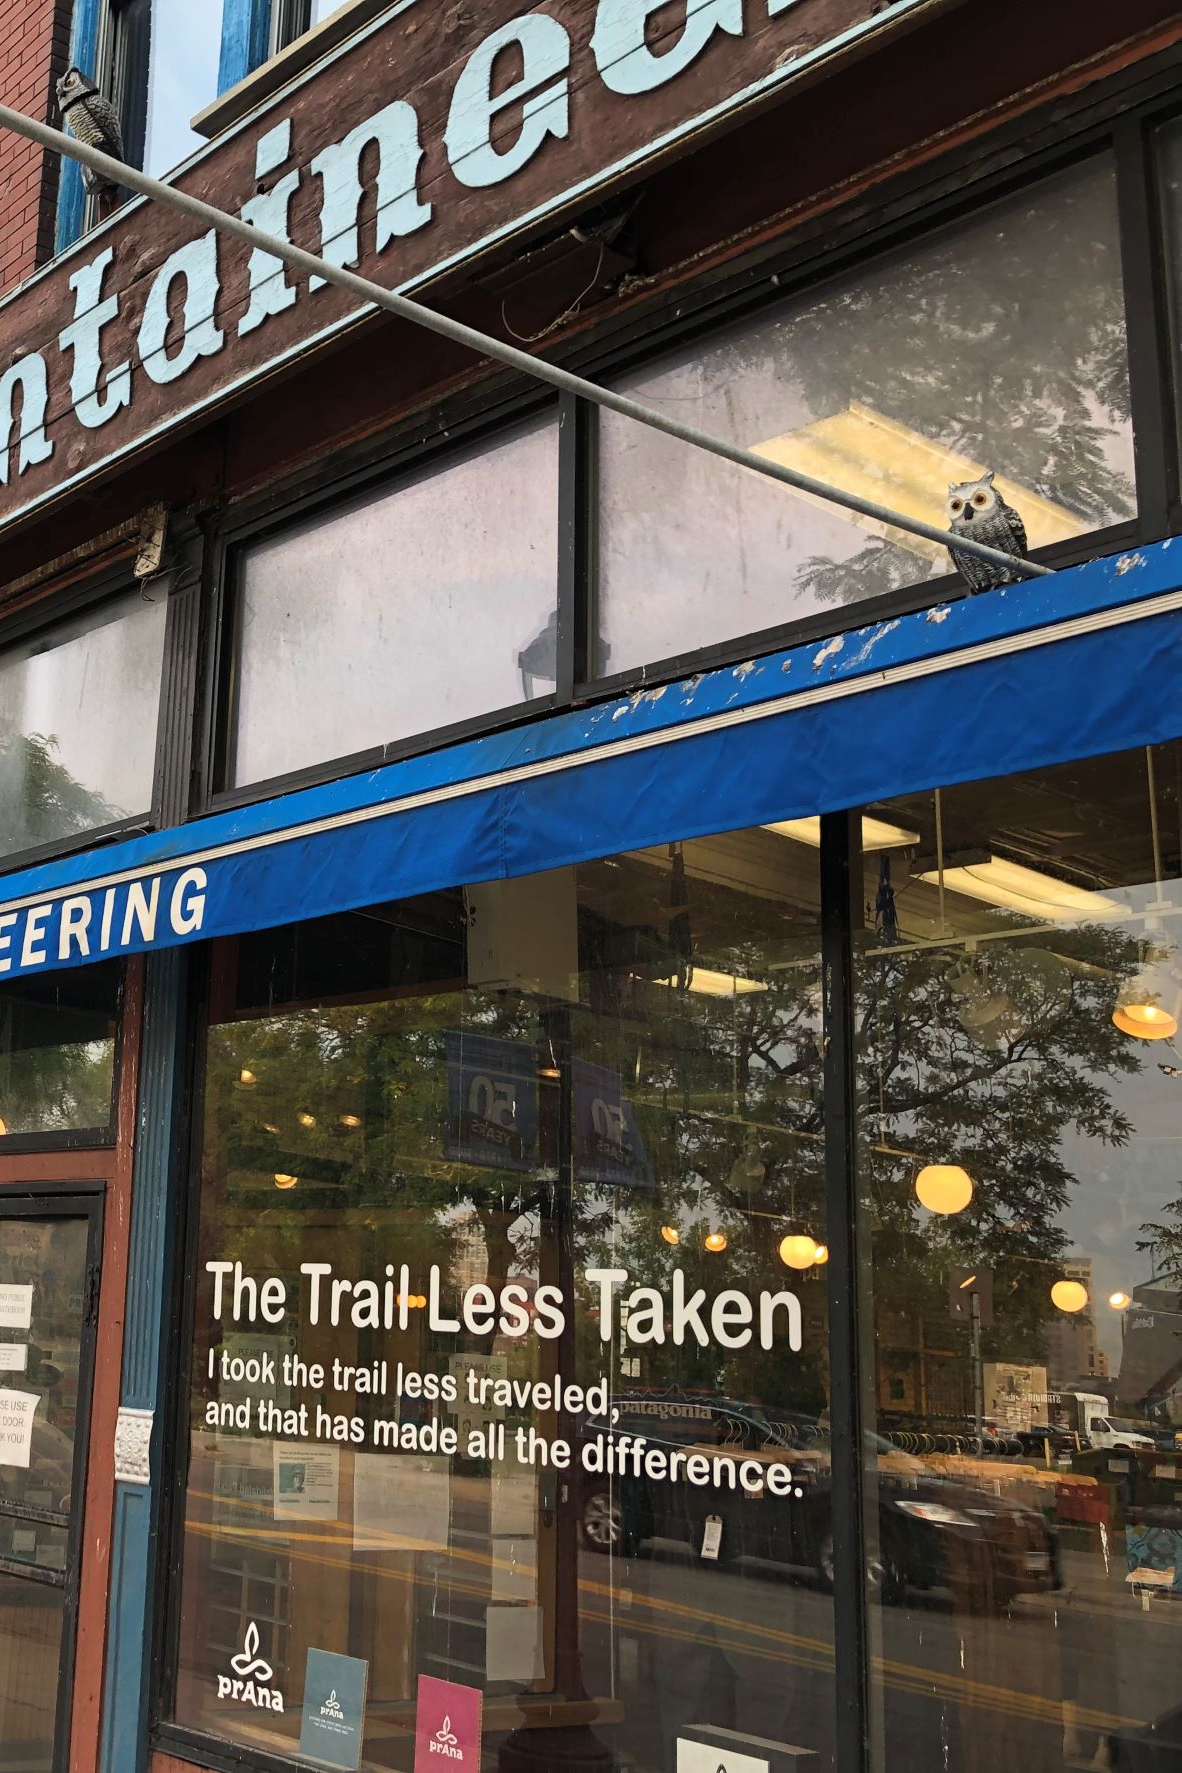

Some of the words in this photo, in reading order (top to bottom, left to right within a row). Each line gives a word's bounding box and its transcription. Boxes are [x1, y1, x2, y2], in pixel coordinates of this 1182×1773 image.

[205, 1260, 286, 1323] The
[300, 1262, 410, 1331] Trail
[429, 1264, 566, 1340] Less
[585, 1268, 803, 1353] Taken
[207, 1347, 215, 1379] I
[221, 1349, 275, 1385] took
[282, 1353, 325, 1389] the
[332, 1358, 387, 1396] trail
[397, 1362, 457, 1402] less
[466, 1368, 620, 1424] traveled,
[10, 1400, 29, 1412] USE
[619, 1402, 713, 1420] patagonia
[7, 1433, 25, 1446] YOU!
[205, 1397, 251, 1430] and
[258, 1399, 309, 1437] that
[316, 1405, 366, 1443] has
[374, 1417, 458, 1455] made
[467, 1423, 505, 1461] all
[514, 1426, 571, 1468] the
[582, 1433, 804, 1498] difference.
[217, 1674, 285, 1713] prAna
[320, 1706, 344, 1720] prAna
[429, 1738, 464, 1761] prAna
